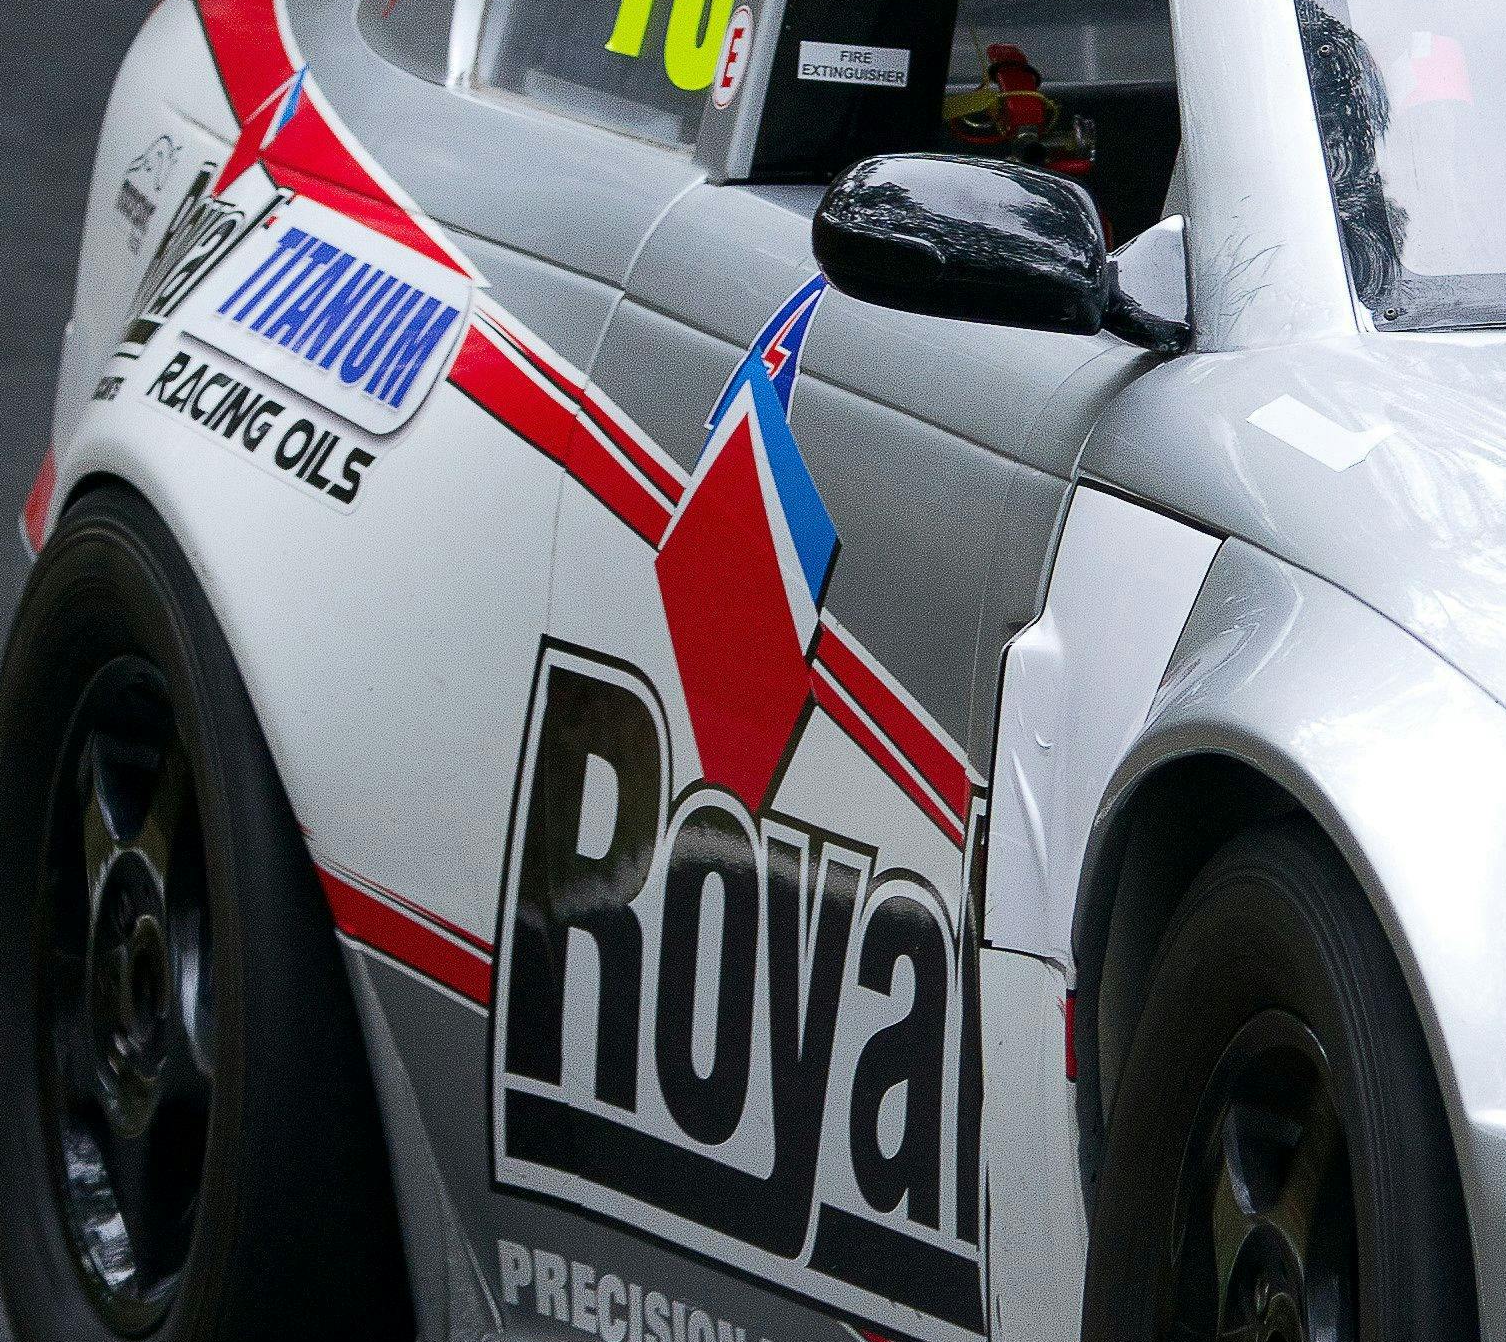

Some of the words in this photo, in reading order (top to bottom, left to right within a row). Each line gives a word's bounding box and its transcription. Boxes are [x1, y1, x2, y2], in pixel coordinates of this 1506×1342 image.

[801, 63, 906, 84] EXTINGUISHER
[839, 50, 873, 64] FIRE
[217, 226, 461, 409] TITANIUM
[145, 350, 286, 452] RACING
[275, 418, 376, 505] OILS
